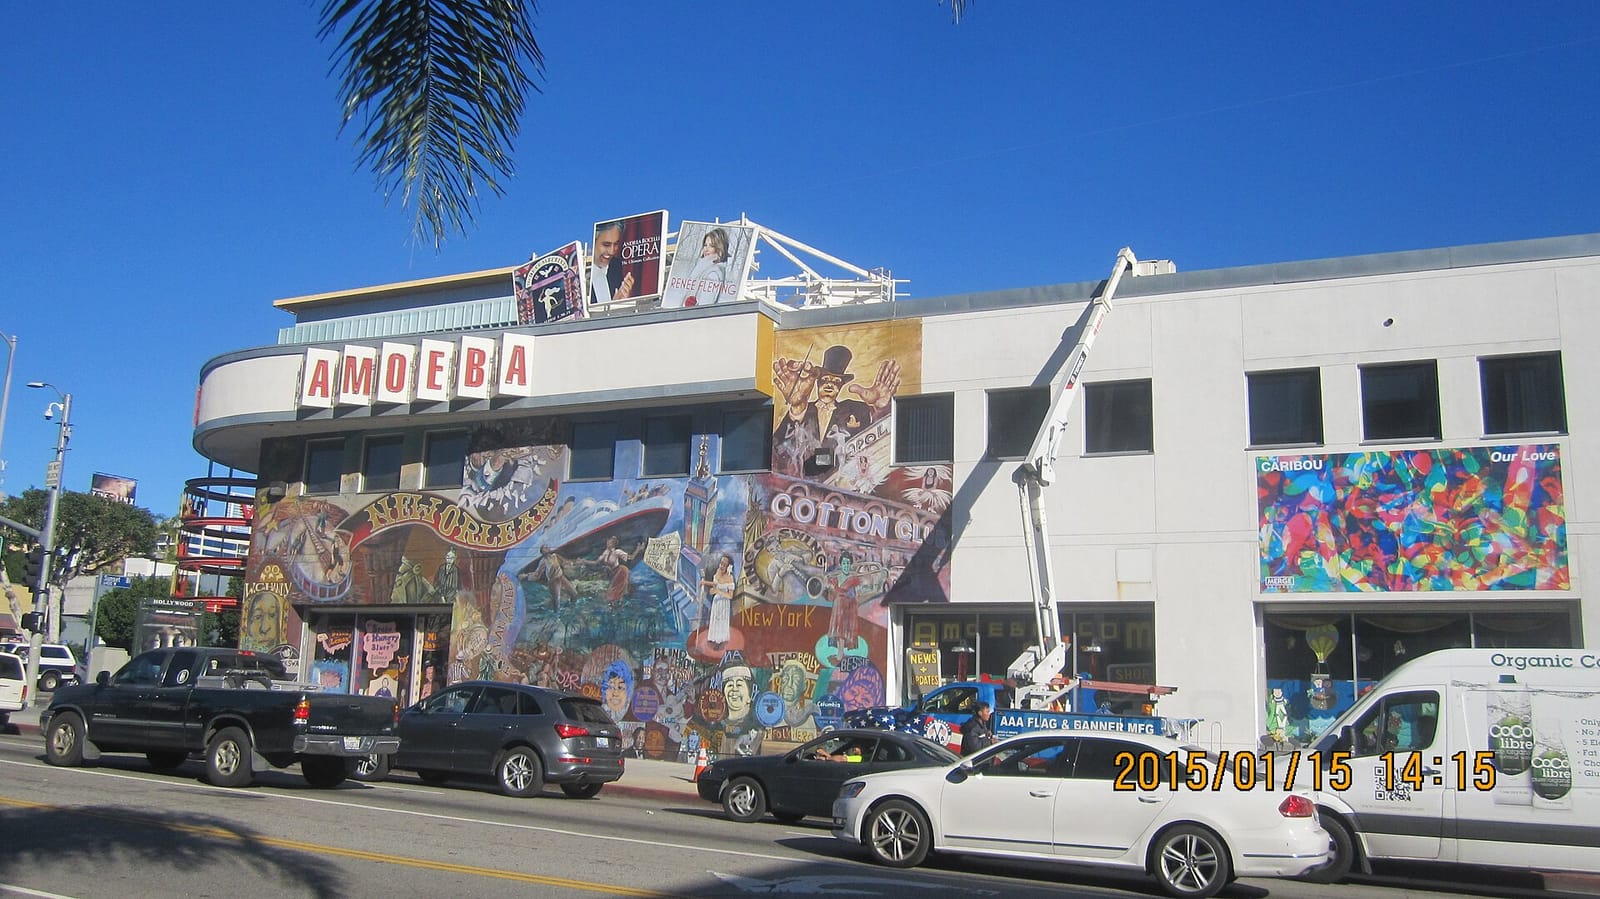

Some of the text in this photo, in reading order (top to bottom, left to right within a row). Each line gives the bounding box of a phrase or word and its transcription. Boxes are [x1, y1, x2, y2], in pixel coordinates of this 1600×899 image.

[621, 242, 659, 259] OPERA
[670, 277, 737, 296] RENEE FLEMING
[308, 344, 527, 398] AMOEBA
[1491, 450, 1556, 463] Our Love
[1261, 460, 1323, 472] CARIBOU
[364, 488, 557, 548] NEW ORLEANS
[771, 493, 889, 539] COTTON
[153, 599, 194, 607] HOLLYWOOD
[910, 653, 937, 664] NEWS
[1491, 653, 1573, 670] Organic
[911, 675, 939, 686] UPDATES
[1000, 715, 1155, 735] AAA FLAG & BANNER MFG
[1581, 728, 1594, 736] No
[1500, 737, 1533, 750] libre
[1542, 768, 1571, 779] libre
